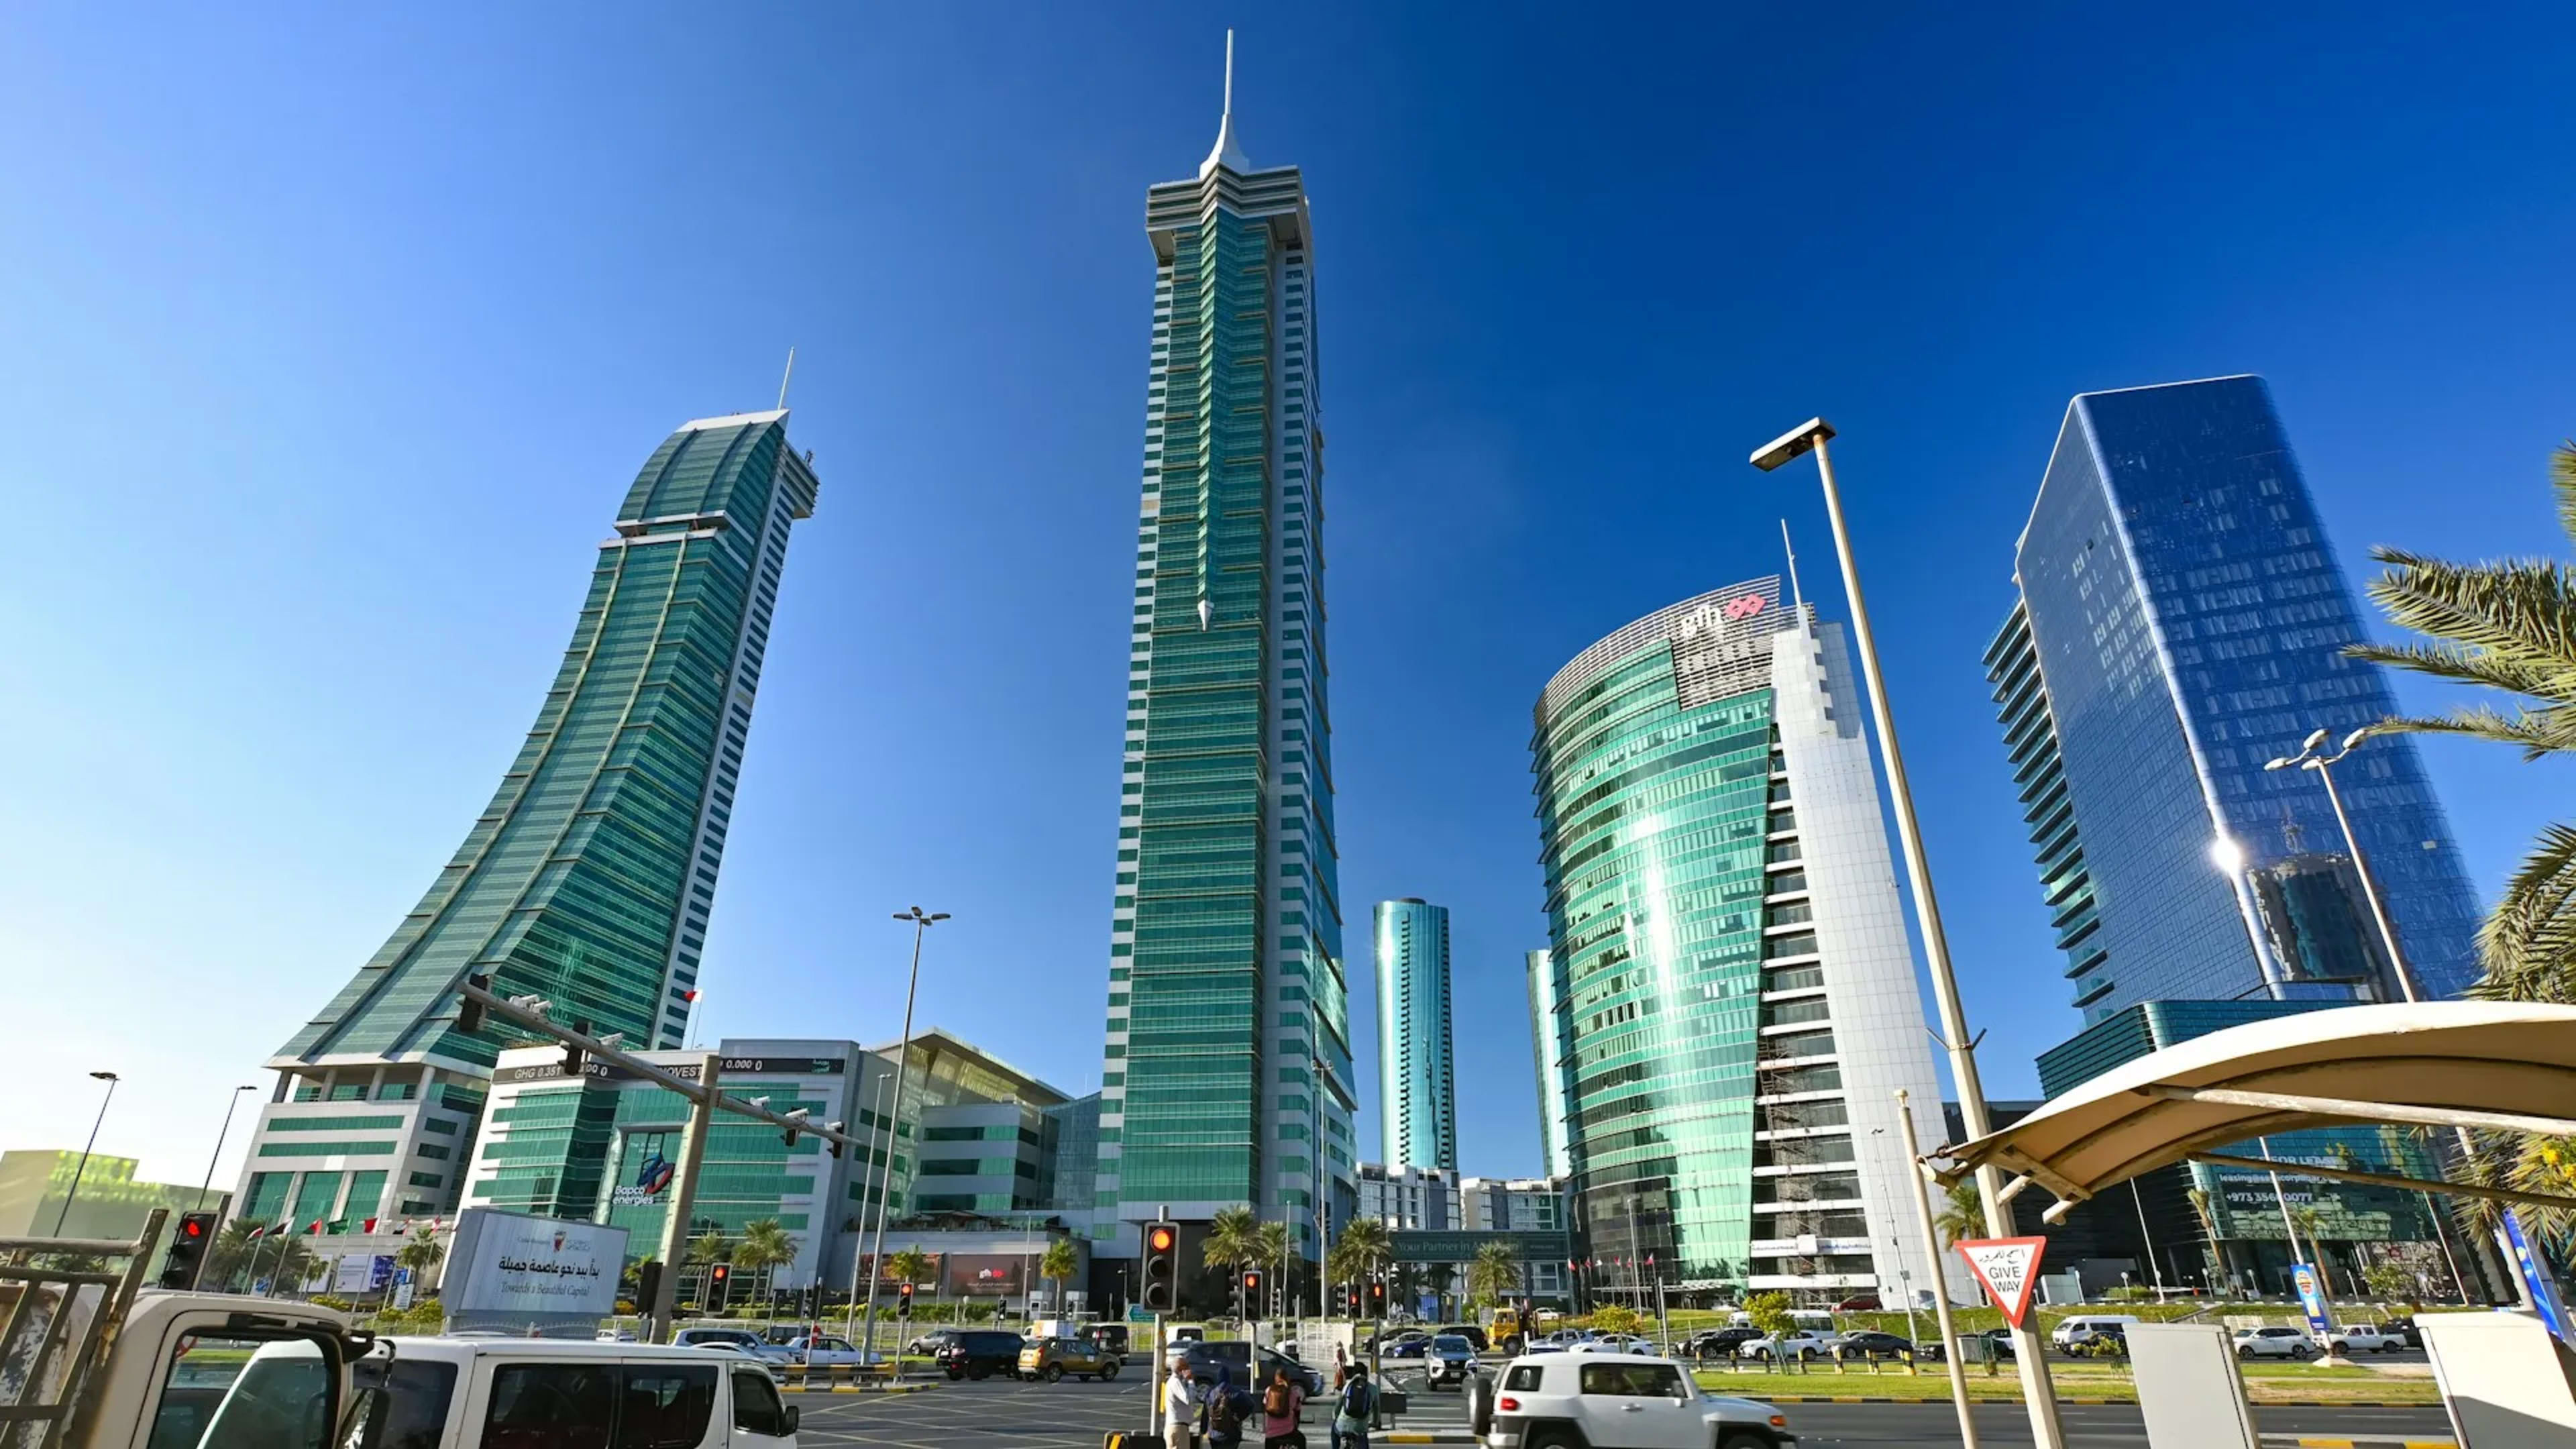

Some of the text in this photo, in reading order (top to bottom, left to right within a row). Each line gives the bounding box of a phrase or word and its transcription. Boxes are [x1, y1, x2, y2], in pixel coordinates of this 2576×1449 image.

[1680, 605, 1723, 638] gfh
[515, 1068, 535, 1079] GHG
[537, 1066, 561, 1077] 0.351
[659, 1066, 702, 1078] NOVEST
[614, 1186, 645, 1197] Bapco
[2226, 1192, 2253, 1202] +973
[2283, 1192, 2313, 1202] 0077
[612, 1195, 654, 1206] energies
[1398, 1242, 1421, 1252] Your
[1423, 1242, 1458, 1251] Partner
[498, 1256, 527, 1275] جميلة
[529, 1258, 558, 1273] عاصمة
[1989, 1267, 2022, 1279] GIVE
[1994, 1281, 2021, 1293] WAY
